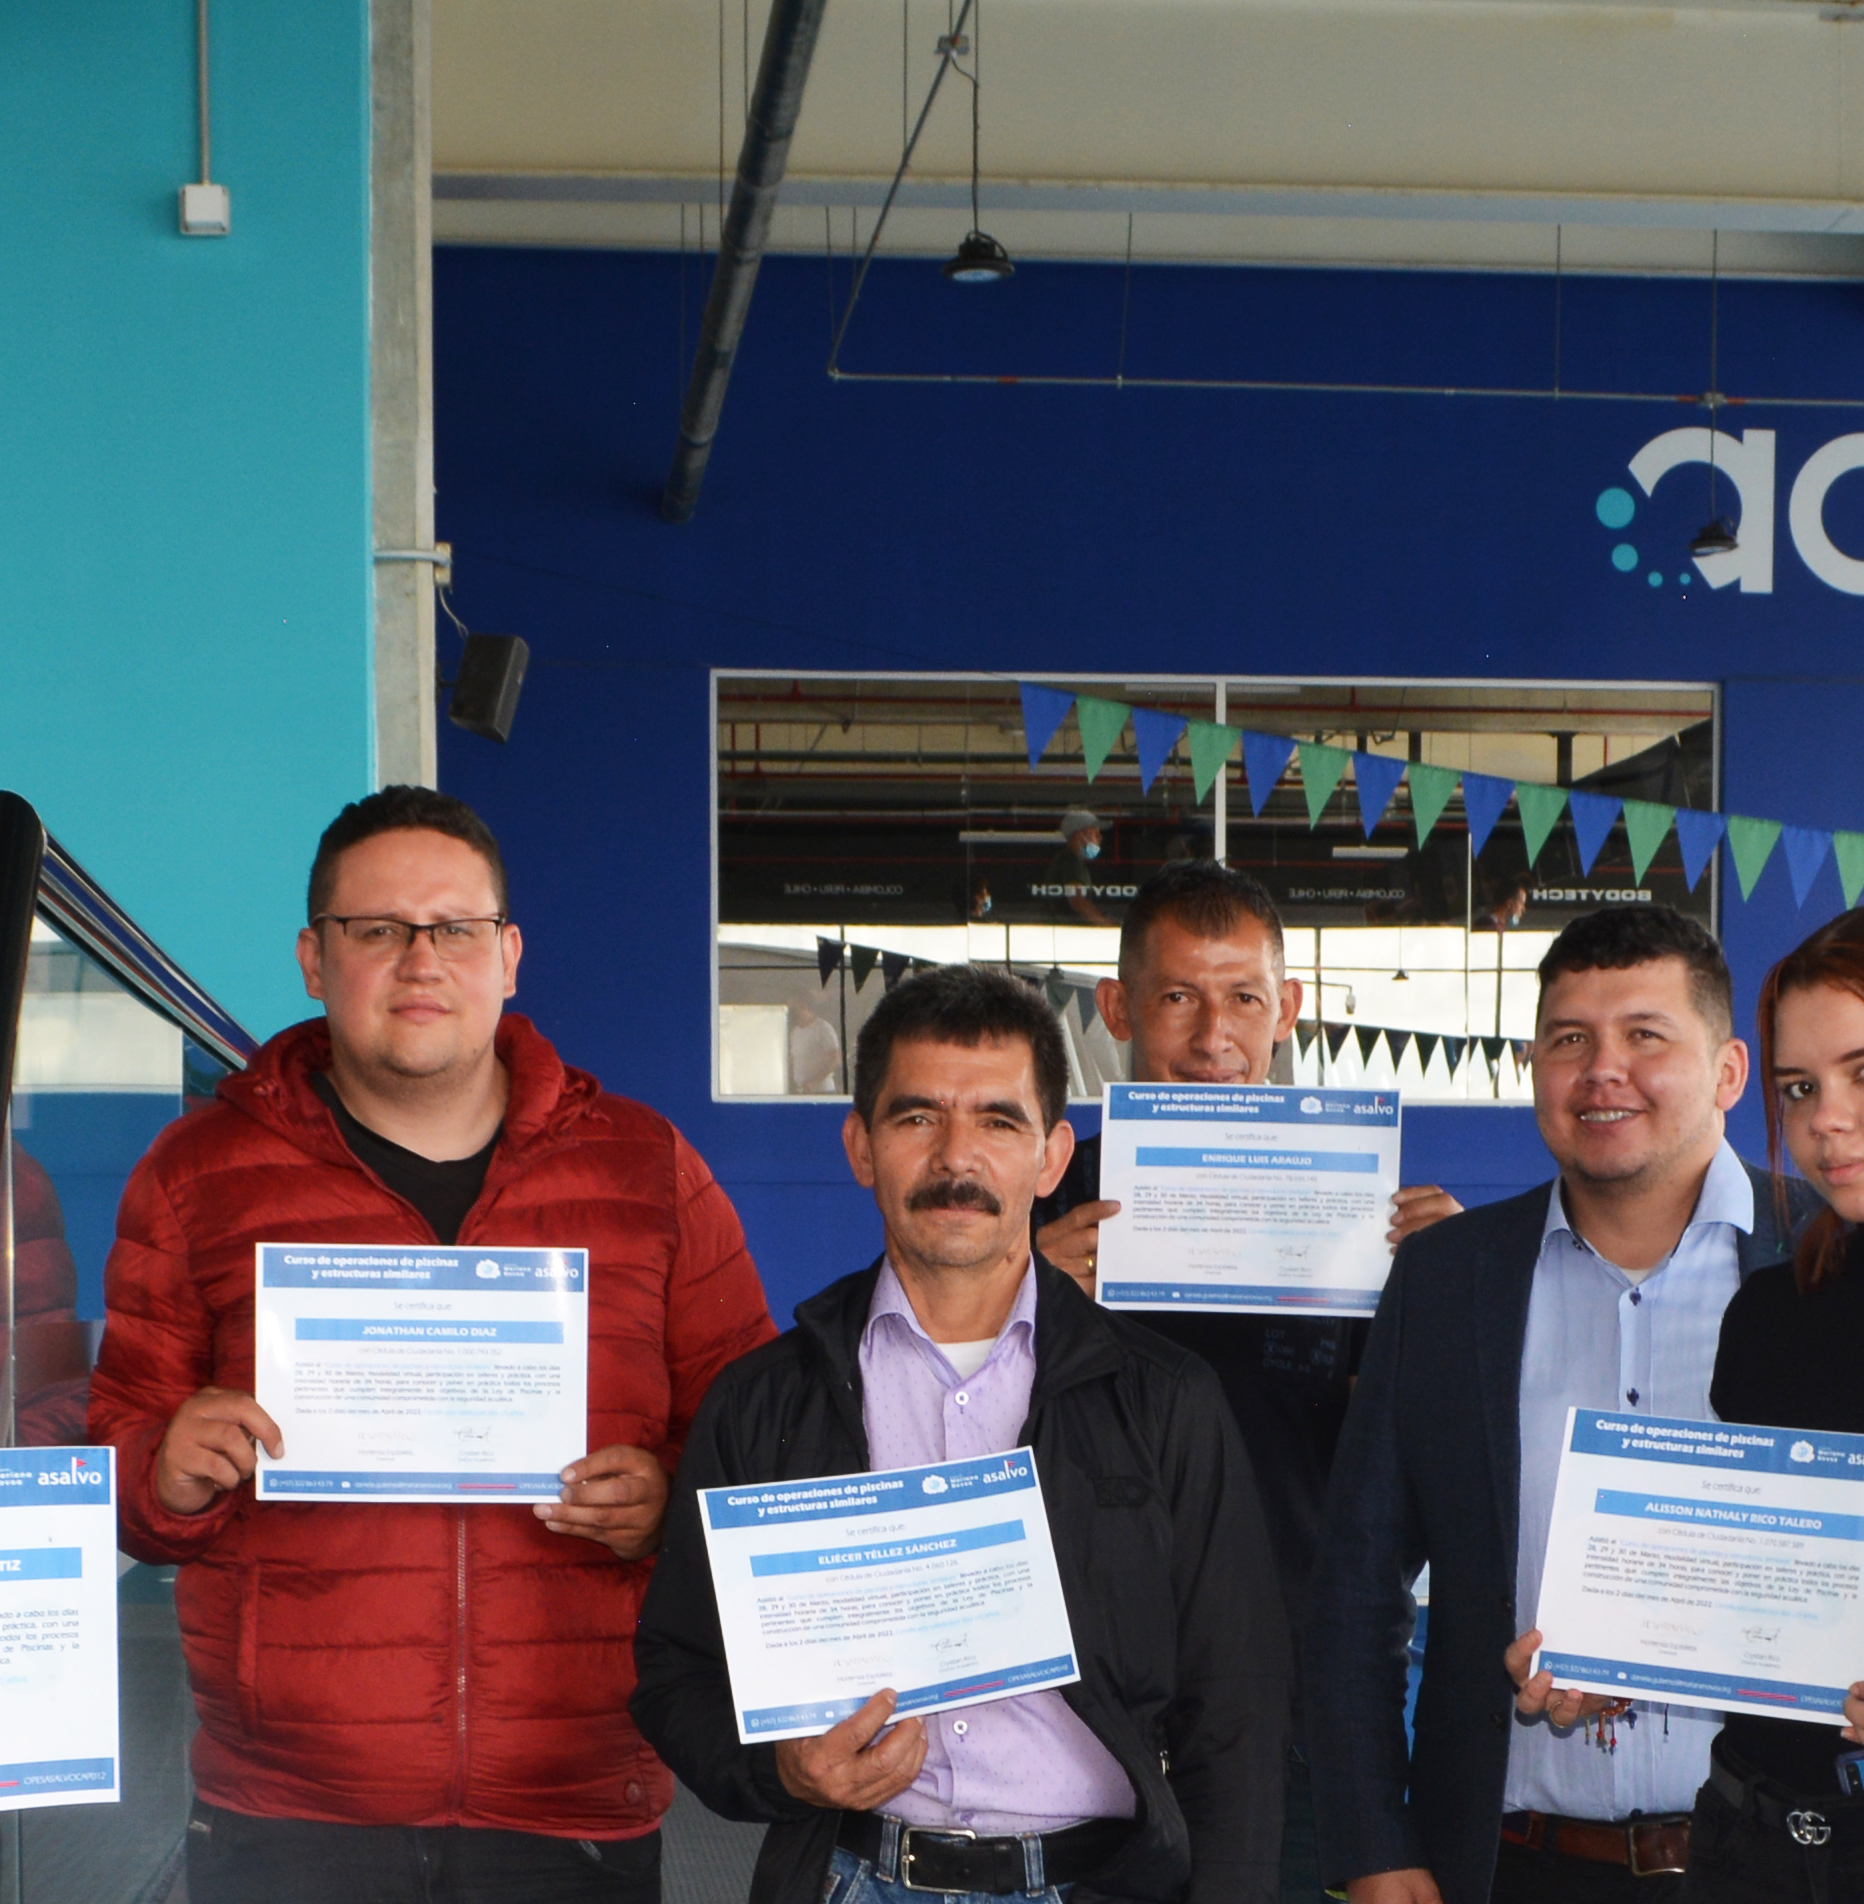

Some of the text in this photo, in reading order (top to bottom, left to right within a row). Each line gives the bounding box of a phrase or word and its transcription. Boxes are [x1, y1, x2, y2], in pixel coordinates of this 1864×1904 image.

[1129, 1091, 1284, 1103] Curso de operaciones de piscinas
[1153, 1103, 1258, 1113] y estructuras similares
[284, 1254, 457, 1269] Curso de operaciones de piscinas
[312, 1269, 429, 1279] y estructuras similares
[362, 1326, 424, 1335] JONATHAN
[425, 1327, 468, 1335] CAMILO
[1595, 1419, 1773, 1448] Curso de operaciones de piscinas
[1622, 1438, 1744, 1458] y estructuras similares
[36, 1456, 103, 1487] asalvo
[981, 1459, 1028, 1485] asalvo
[727, 1478, 903, 1506] Curso de operaciones de piscinas
[758, 1493, 877, 1517] y estructuras similares
[1645, 1502, 1822, 1529] ALISSON NATHALY RICO TALERO
[818, 1538, 957, 1566] ELIÉCER TÉLLEZ SÁNCHEZ
